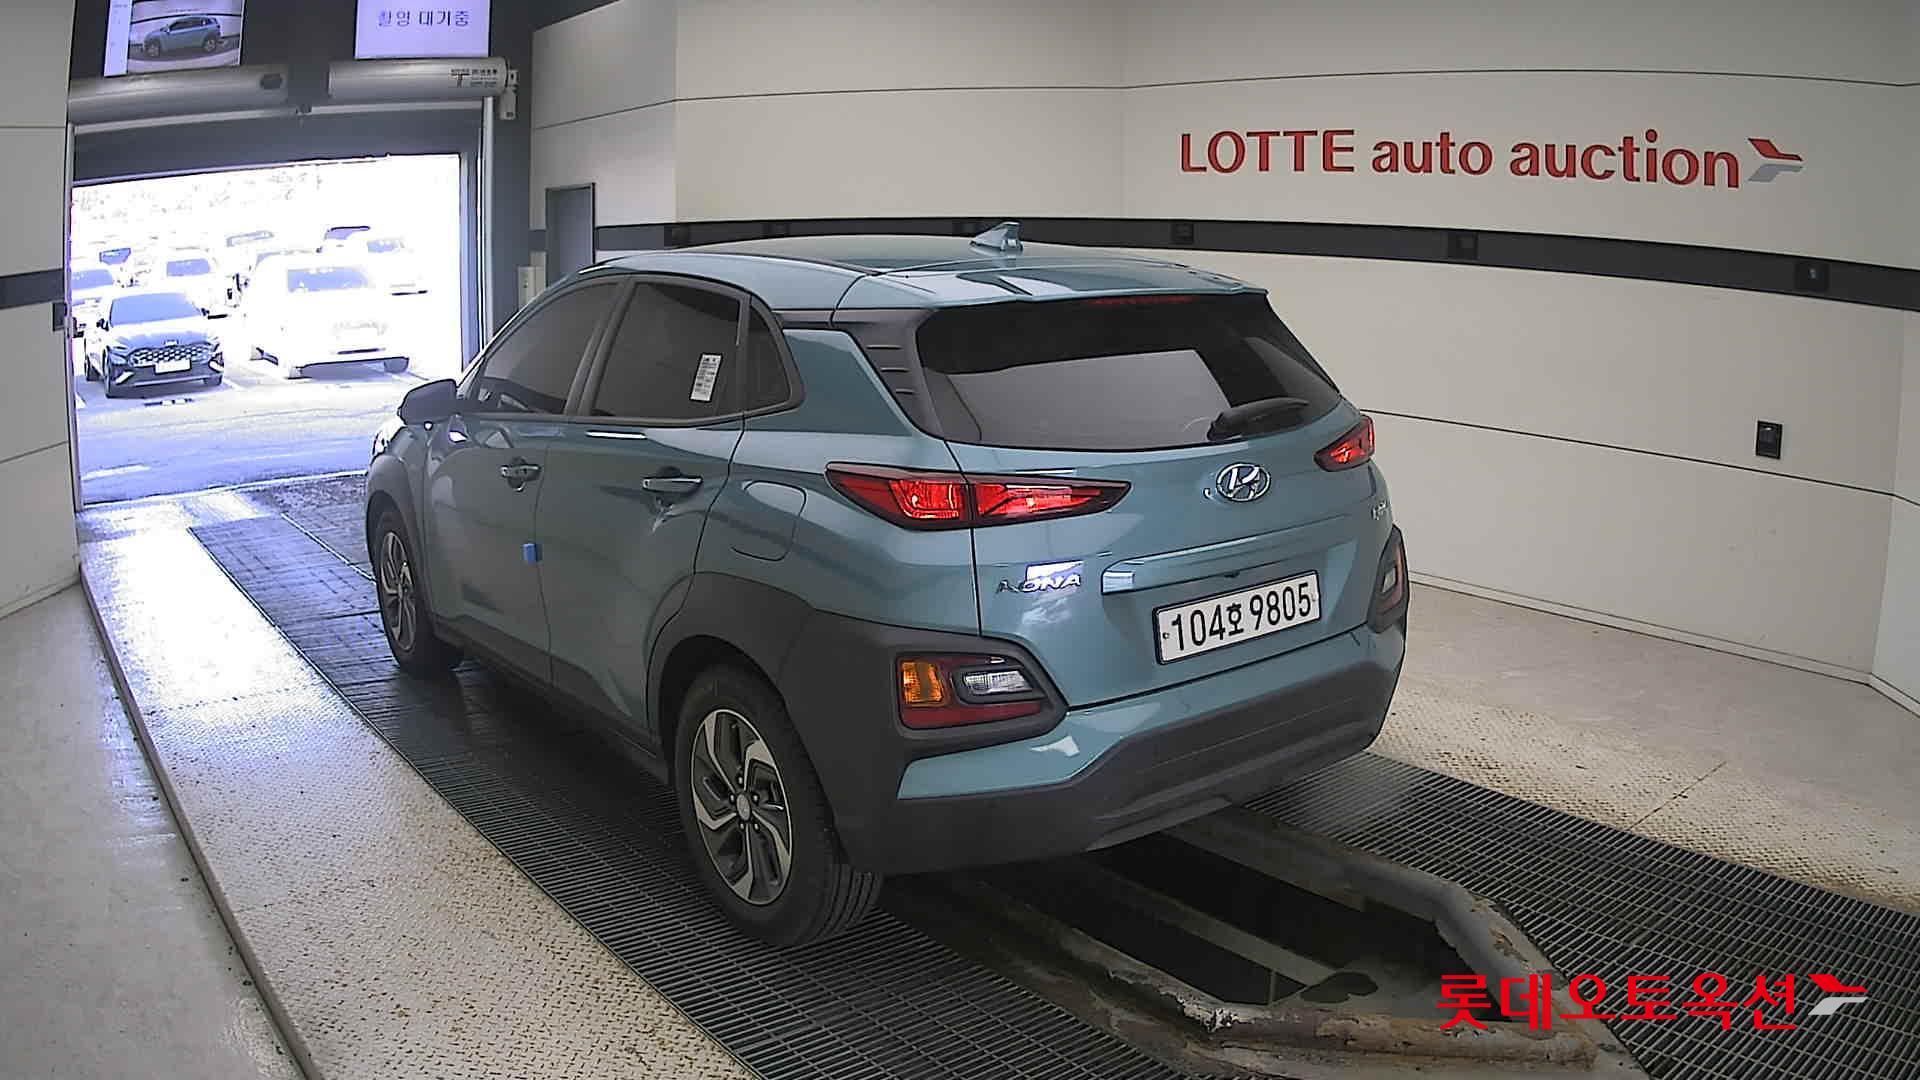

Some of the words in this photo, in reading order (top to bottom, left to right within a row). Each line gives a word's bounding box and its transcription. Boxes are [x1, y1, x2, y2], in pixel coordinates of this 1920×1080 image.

[418, 9, 470, 28] 대기중
[1180, 129, 1354, 174] LOTTE
[1371, 131, 1494, 176] auto
[1509, 128, 1741, 188] auction
[1171, 603, 1244, 651] 104호
[1249, 582, 1312, 631] 9805
